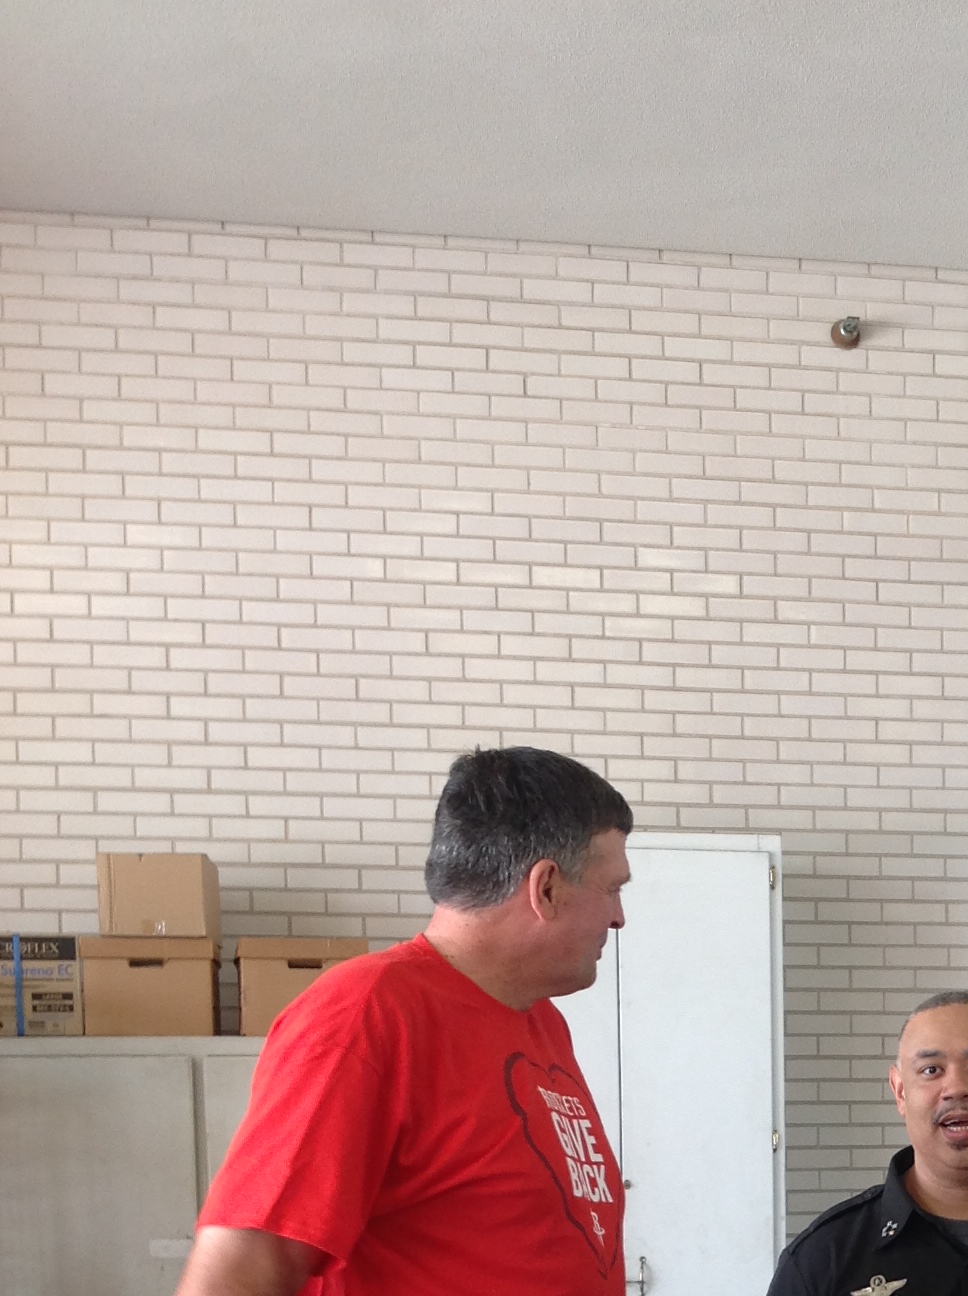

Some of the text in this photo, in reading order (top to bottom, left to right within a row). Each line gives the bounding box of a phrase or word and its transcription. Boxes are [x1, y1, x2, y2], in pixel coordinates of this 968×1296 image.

[1, 963, 54, 976] Sureno
[551, 1111, 604, 1163] GIVE
[566, 1157, 613, 1202] BACK
